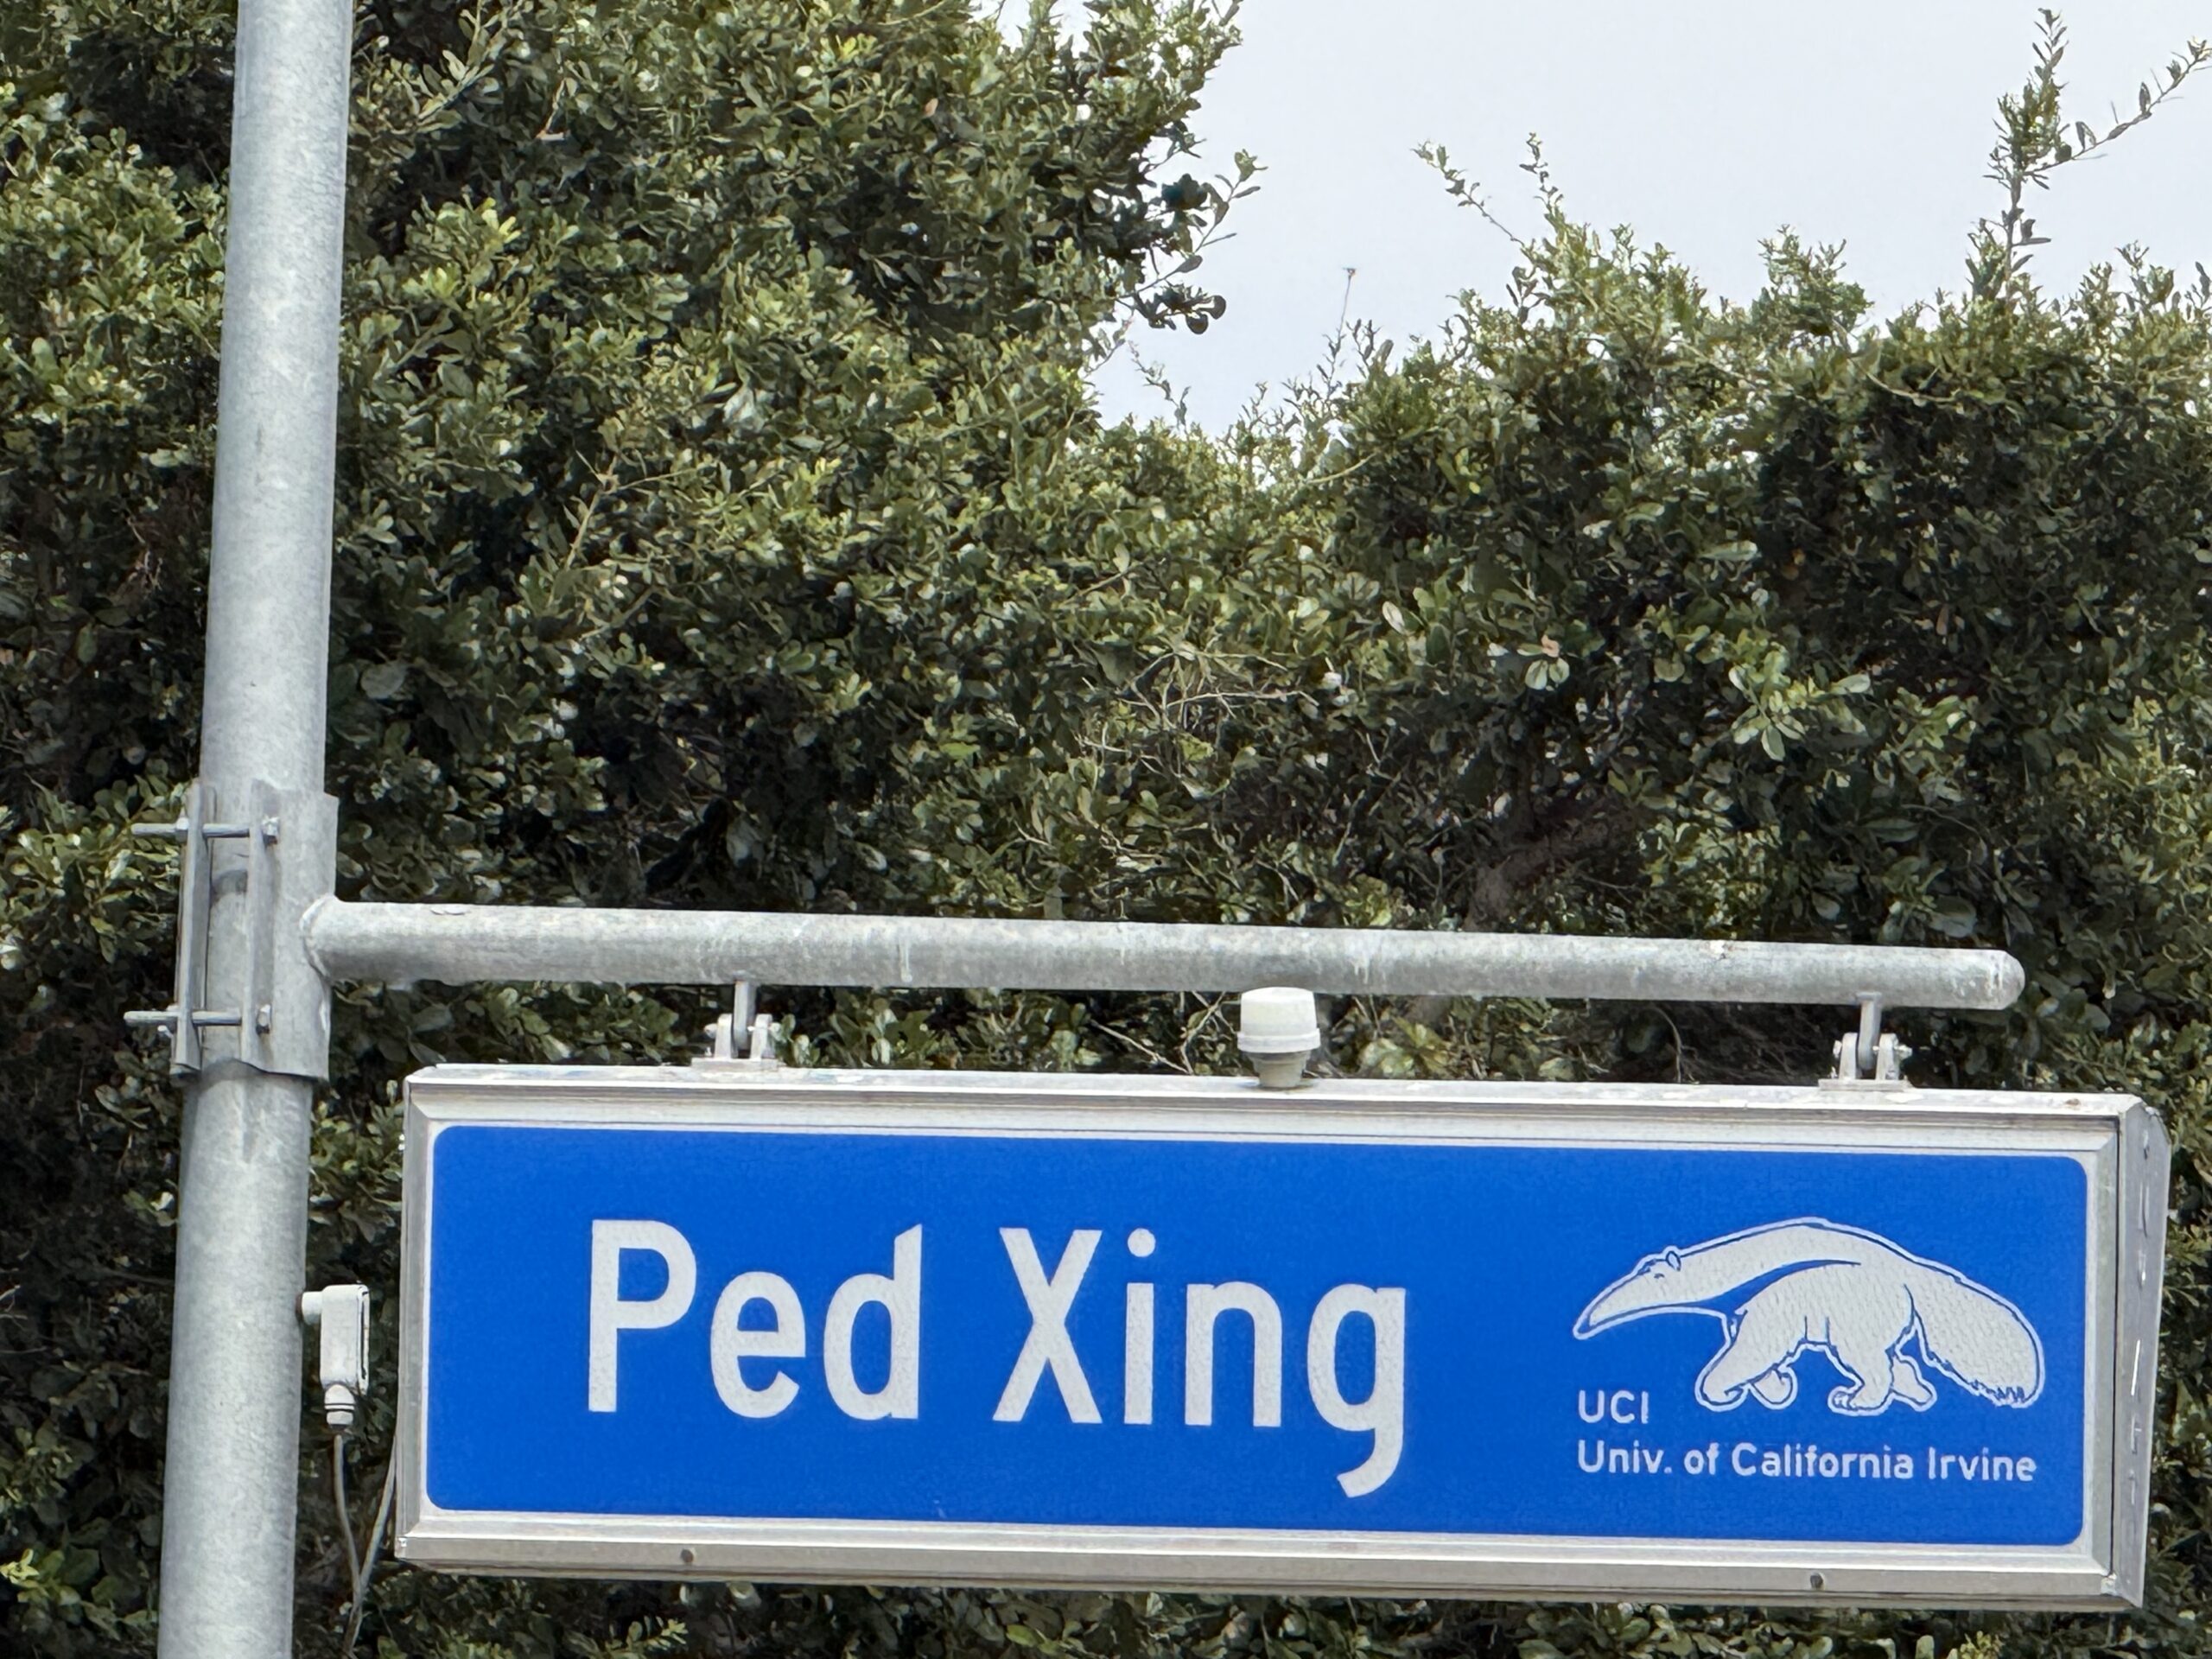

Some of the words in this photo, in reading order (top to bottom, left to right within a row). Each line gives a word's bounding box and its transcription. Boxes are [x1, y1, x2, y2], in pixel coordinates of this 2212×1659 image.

[587, 1218, 924, 1421] Ped
[991, 1226, 1408, 1499] Xing
[1577, 1389, 1649, 1425] UCI
[1577, 1439, 1673, 1474] Univ.
[1682, 1441, 1720, 1476] of
[1731, 1441, 1915, 1480] California
[1927, 1446, 2037, 1483] Irvine
